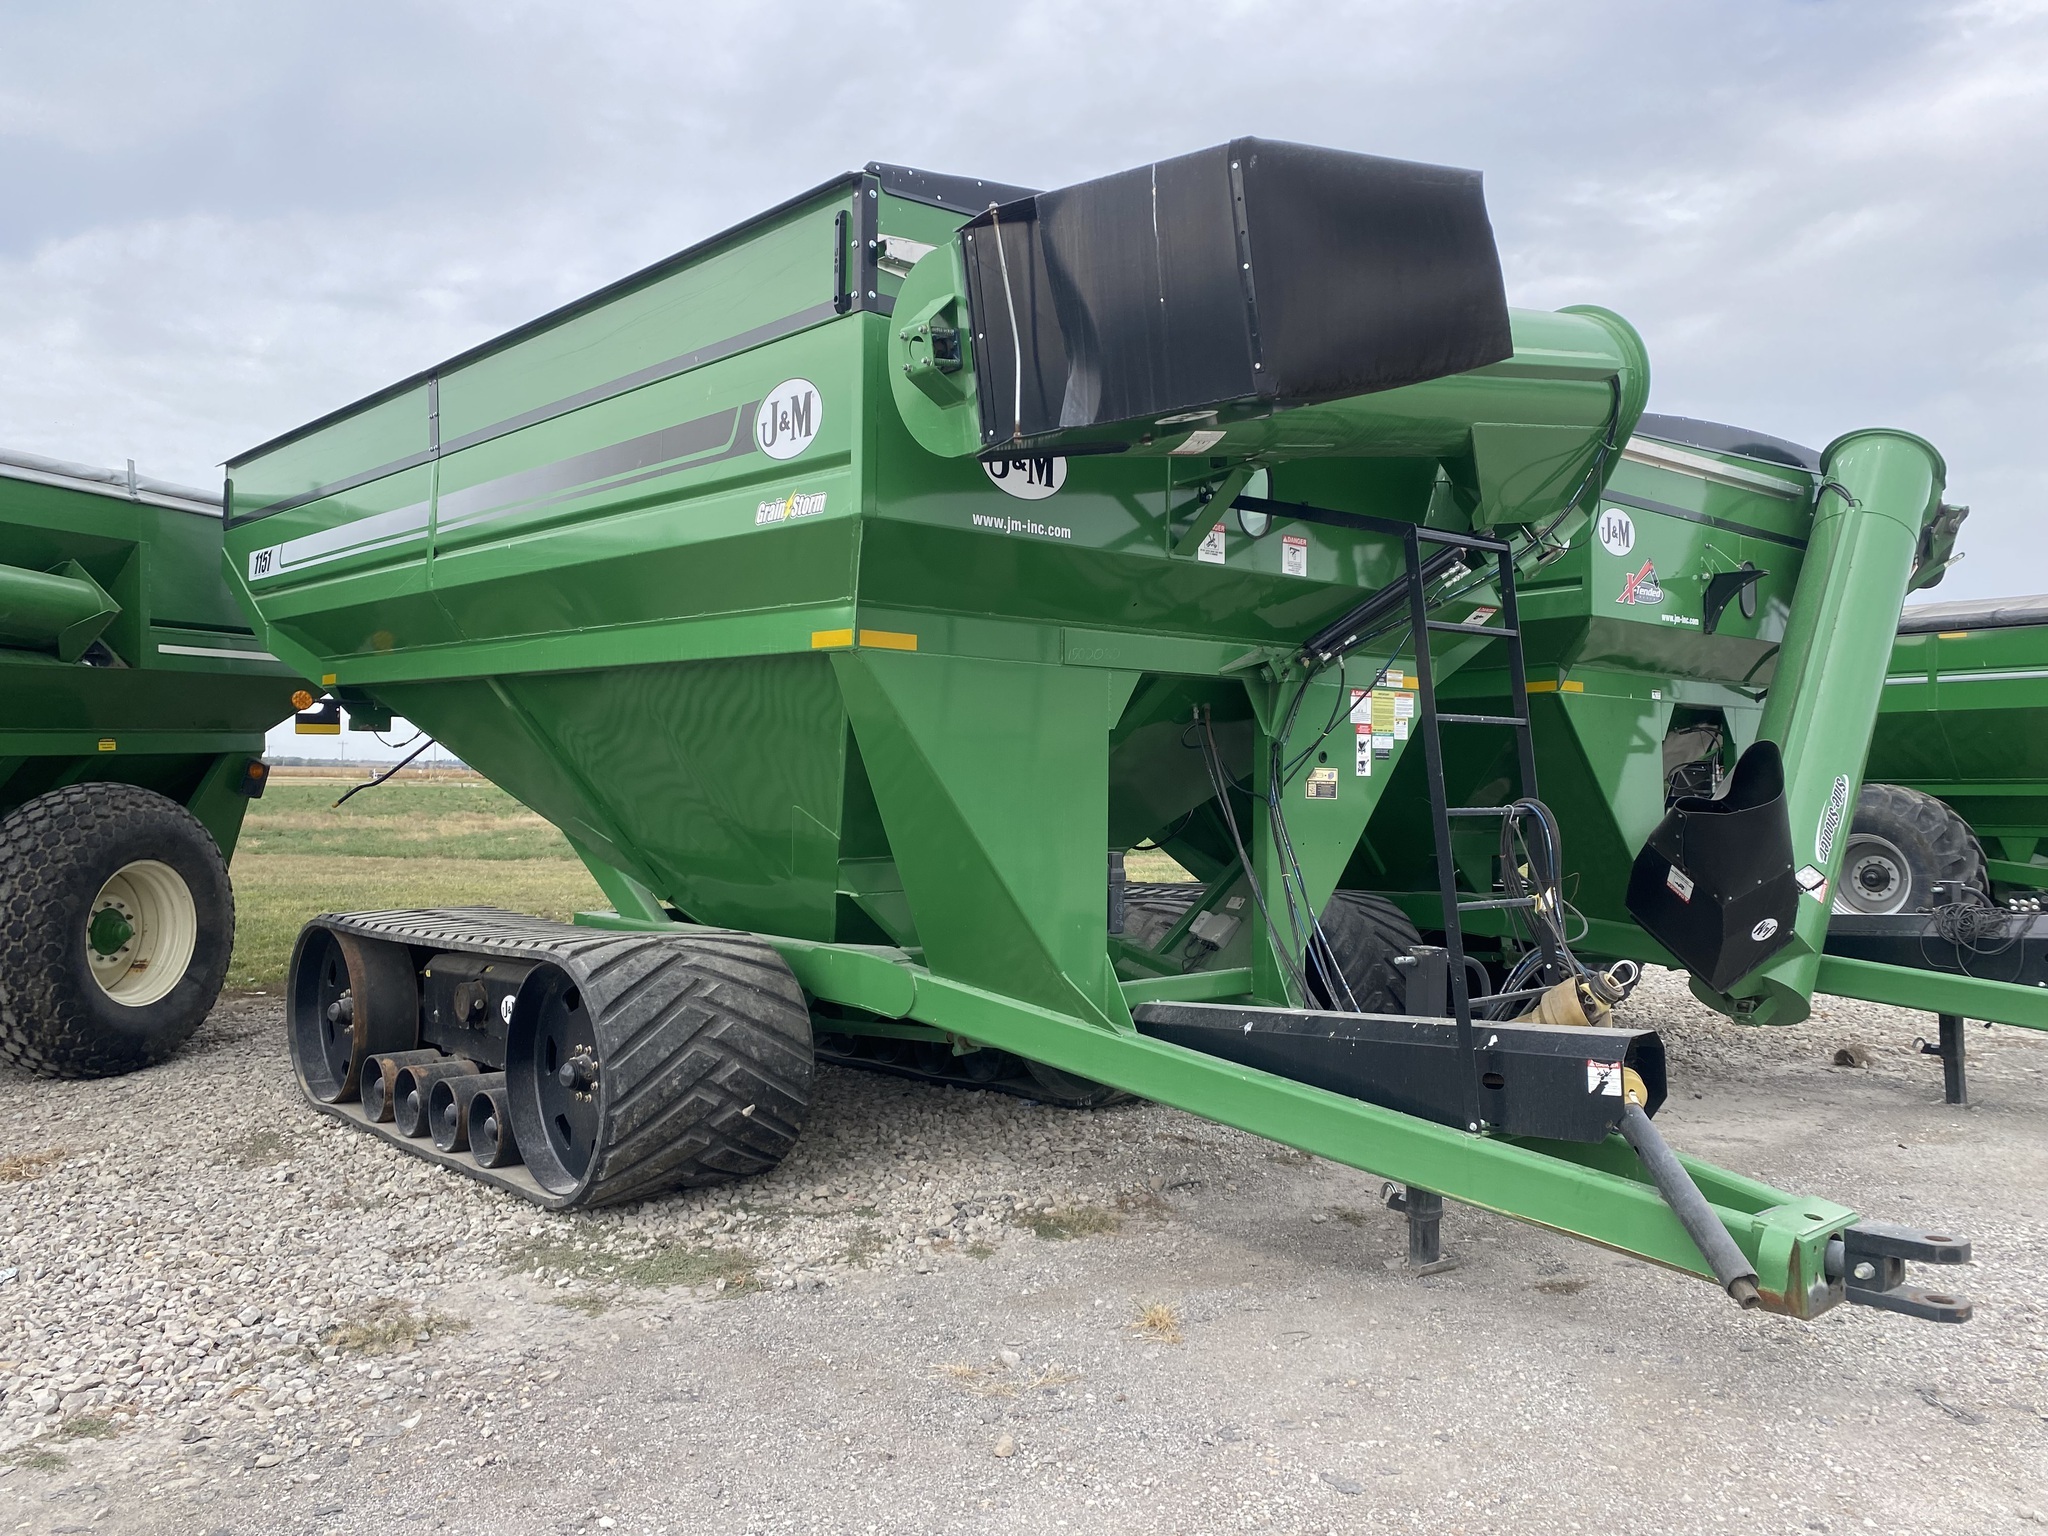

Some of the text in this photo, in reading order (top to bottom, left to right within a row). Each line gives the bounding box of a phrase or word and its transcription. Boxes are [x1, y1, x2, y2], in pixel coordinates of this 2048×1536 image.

[761, 390, 813, 448] J&M
[756, 492, 827, 525] Grain Storm
[972, 513, 1071, 539] www.jm-inc.com
[1286, 536, 1307, 546] DANGER
[1601, 517, 1631, 548] J&M
[255, 550, 272, 574] 1151
[1819, 776, 1847, 864] Side-Shooter
